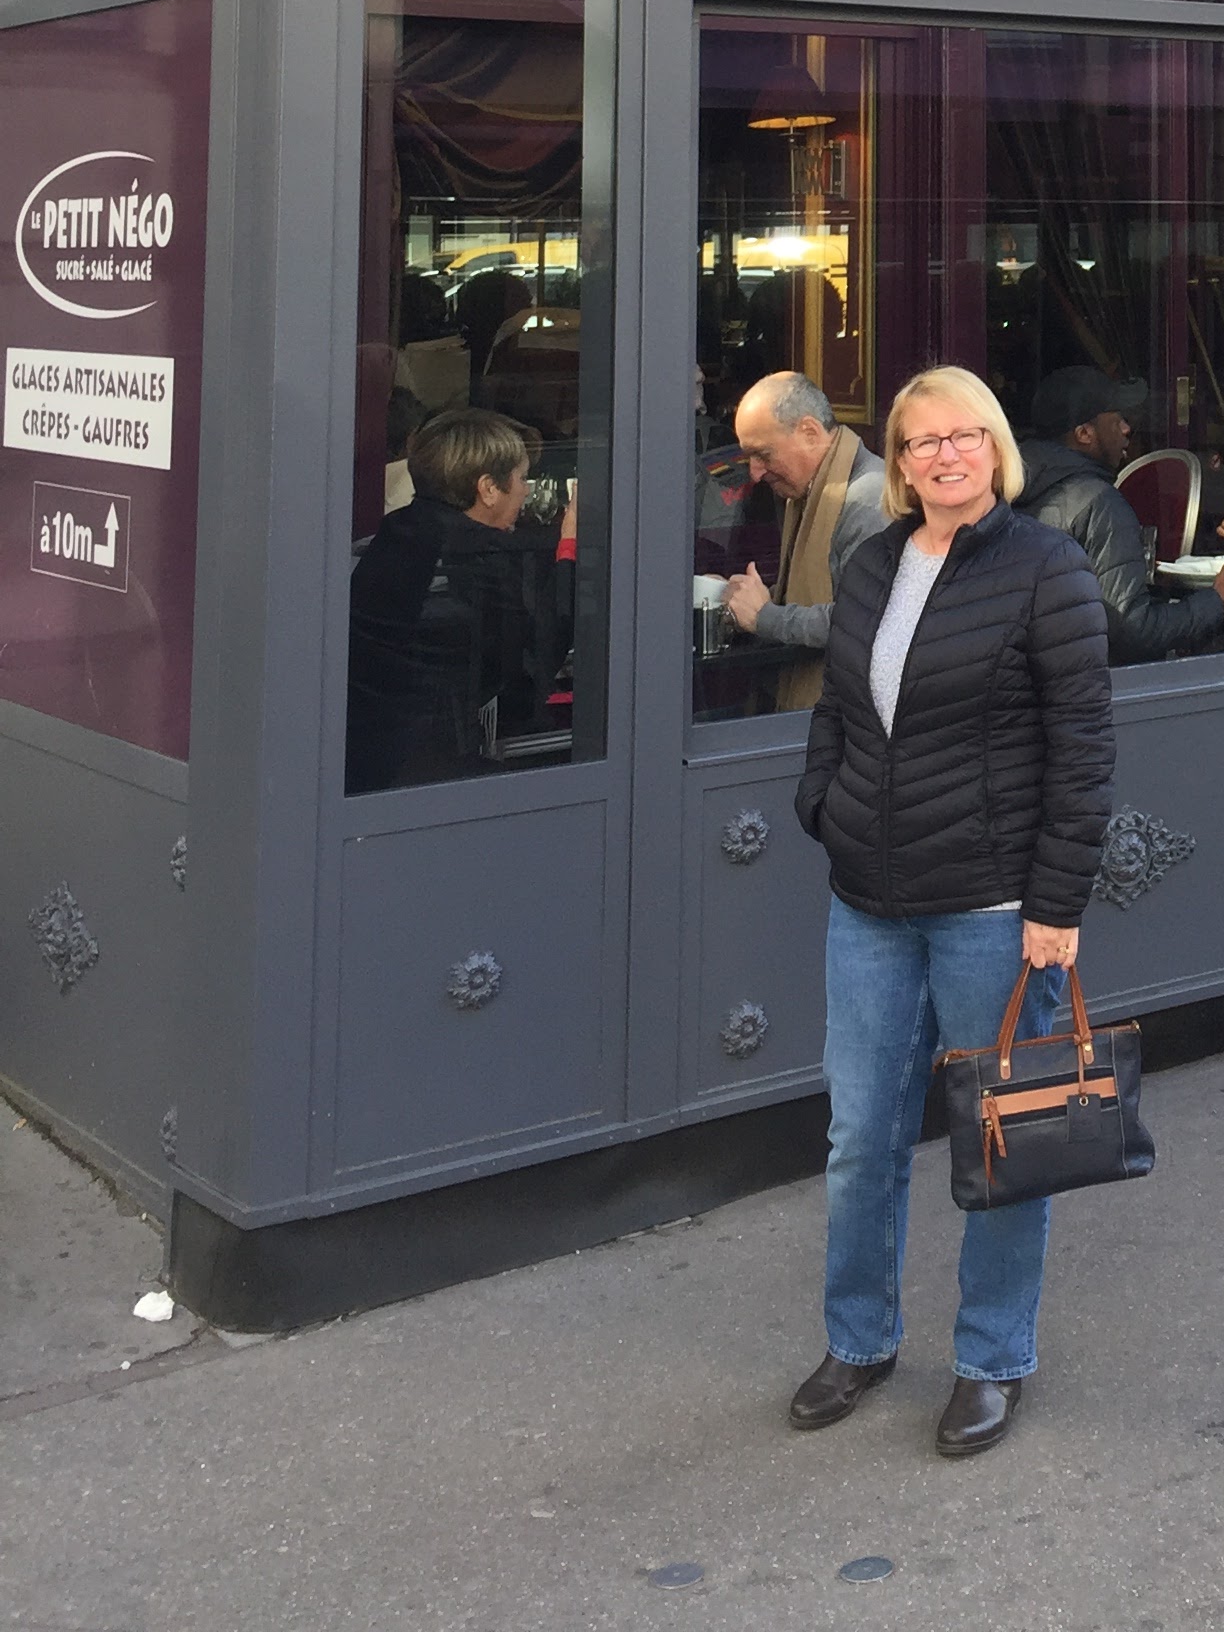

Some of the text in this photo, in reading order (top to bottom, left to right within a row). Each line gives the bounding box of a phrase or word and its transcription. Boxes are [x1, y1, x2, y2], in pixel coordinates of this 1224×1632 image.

[31, 177, 174, 249] LE PETIT NÉGO
[12, 363, 165, 403] GLACES ARTISANALES
[22, 403, 70, 440] CRÊPES
[82, 416, 149, 451] GAUFRES
